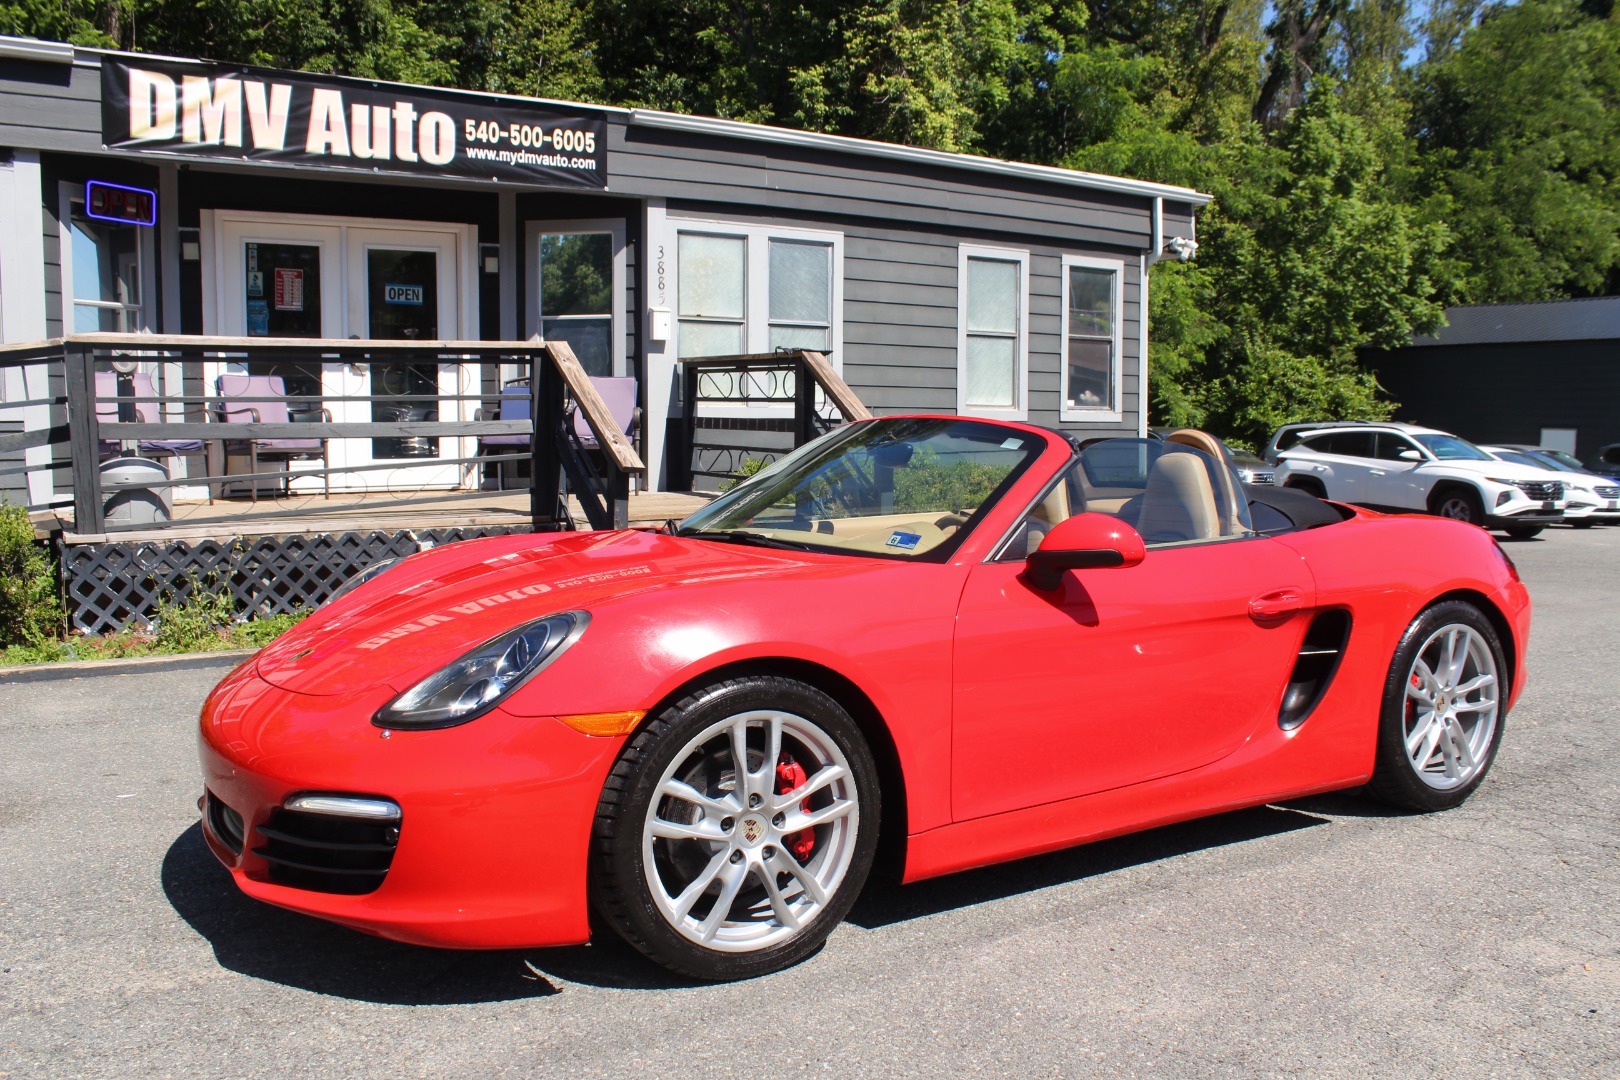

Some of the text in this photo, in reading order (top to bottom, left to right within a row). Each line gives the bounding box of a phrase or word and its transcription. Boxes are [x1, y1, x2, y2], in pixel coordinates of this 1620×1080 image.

[129, 67, 457, 166] DMV Auto
[465, 118, 596, 154] 540-500-6005
[465, 147, 597, 171] www.mydmvauto.com
[91, 186, 152, 222] OPEN
[388, 287, 420, 301] OPEN
